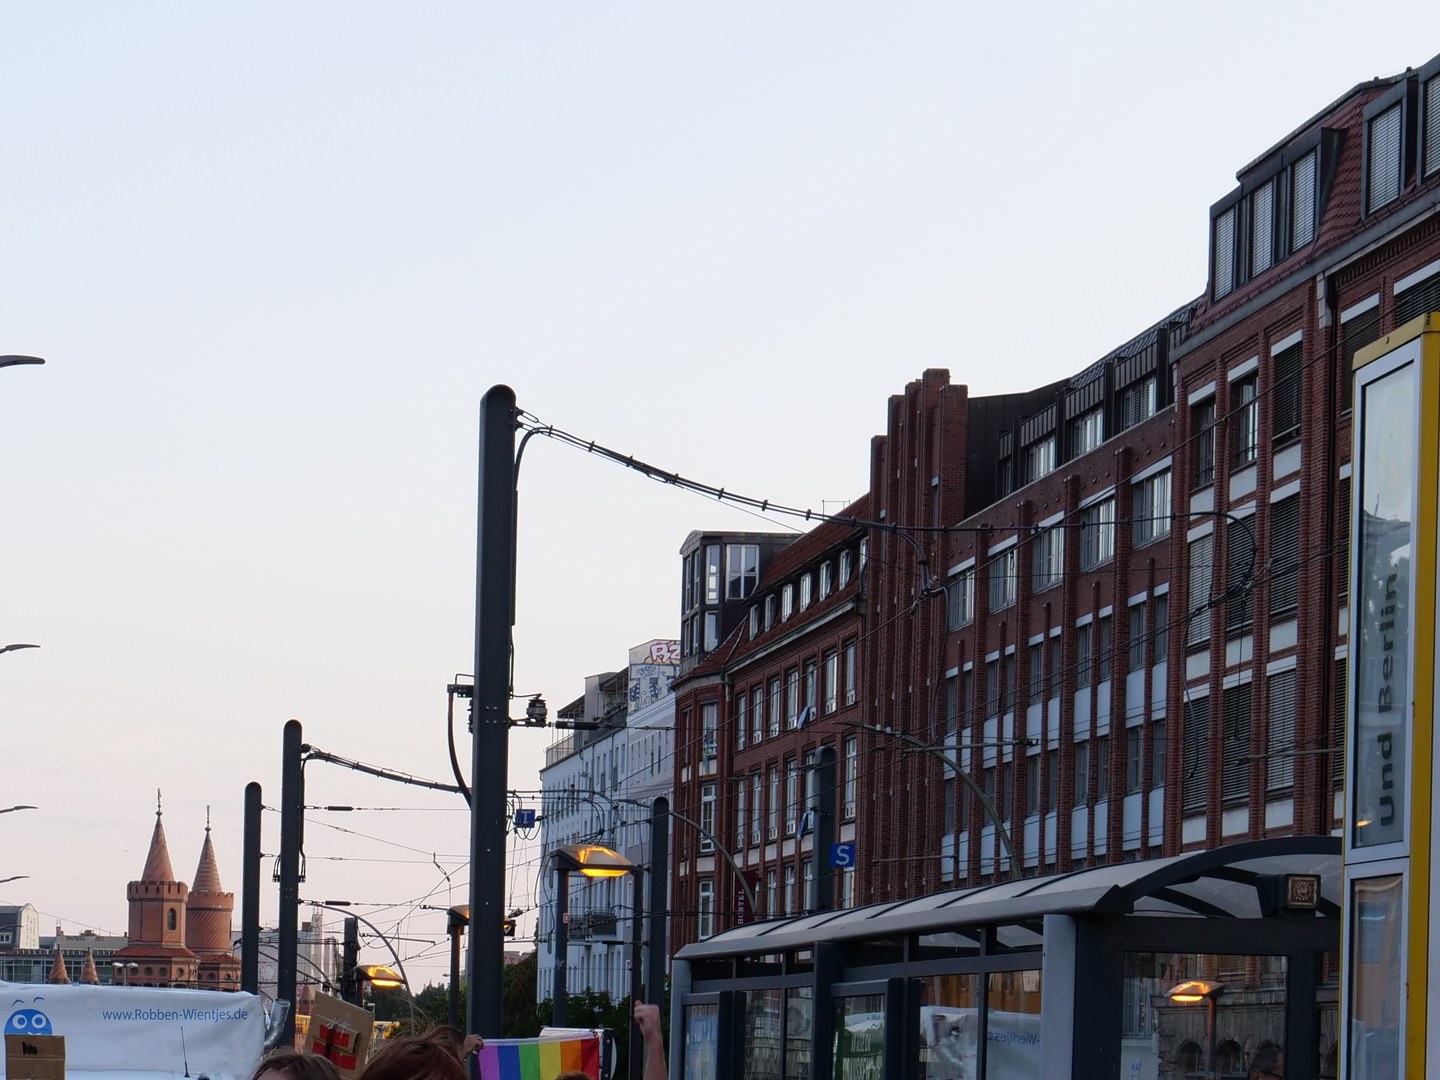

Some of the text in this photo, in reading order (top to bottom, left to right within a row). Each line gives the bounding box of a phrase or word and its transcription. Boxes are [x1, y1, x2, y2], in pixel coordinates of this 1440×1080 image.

[1378, 573, 1398, 713] Berlin
[835, 844, 850, 866] S
[737, 887, 745, 925] HOSTEL
[102, 1008, 248, 1023] www.Robben-Wientjes.de
